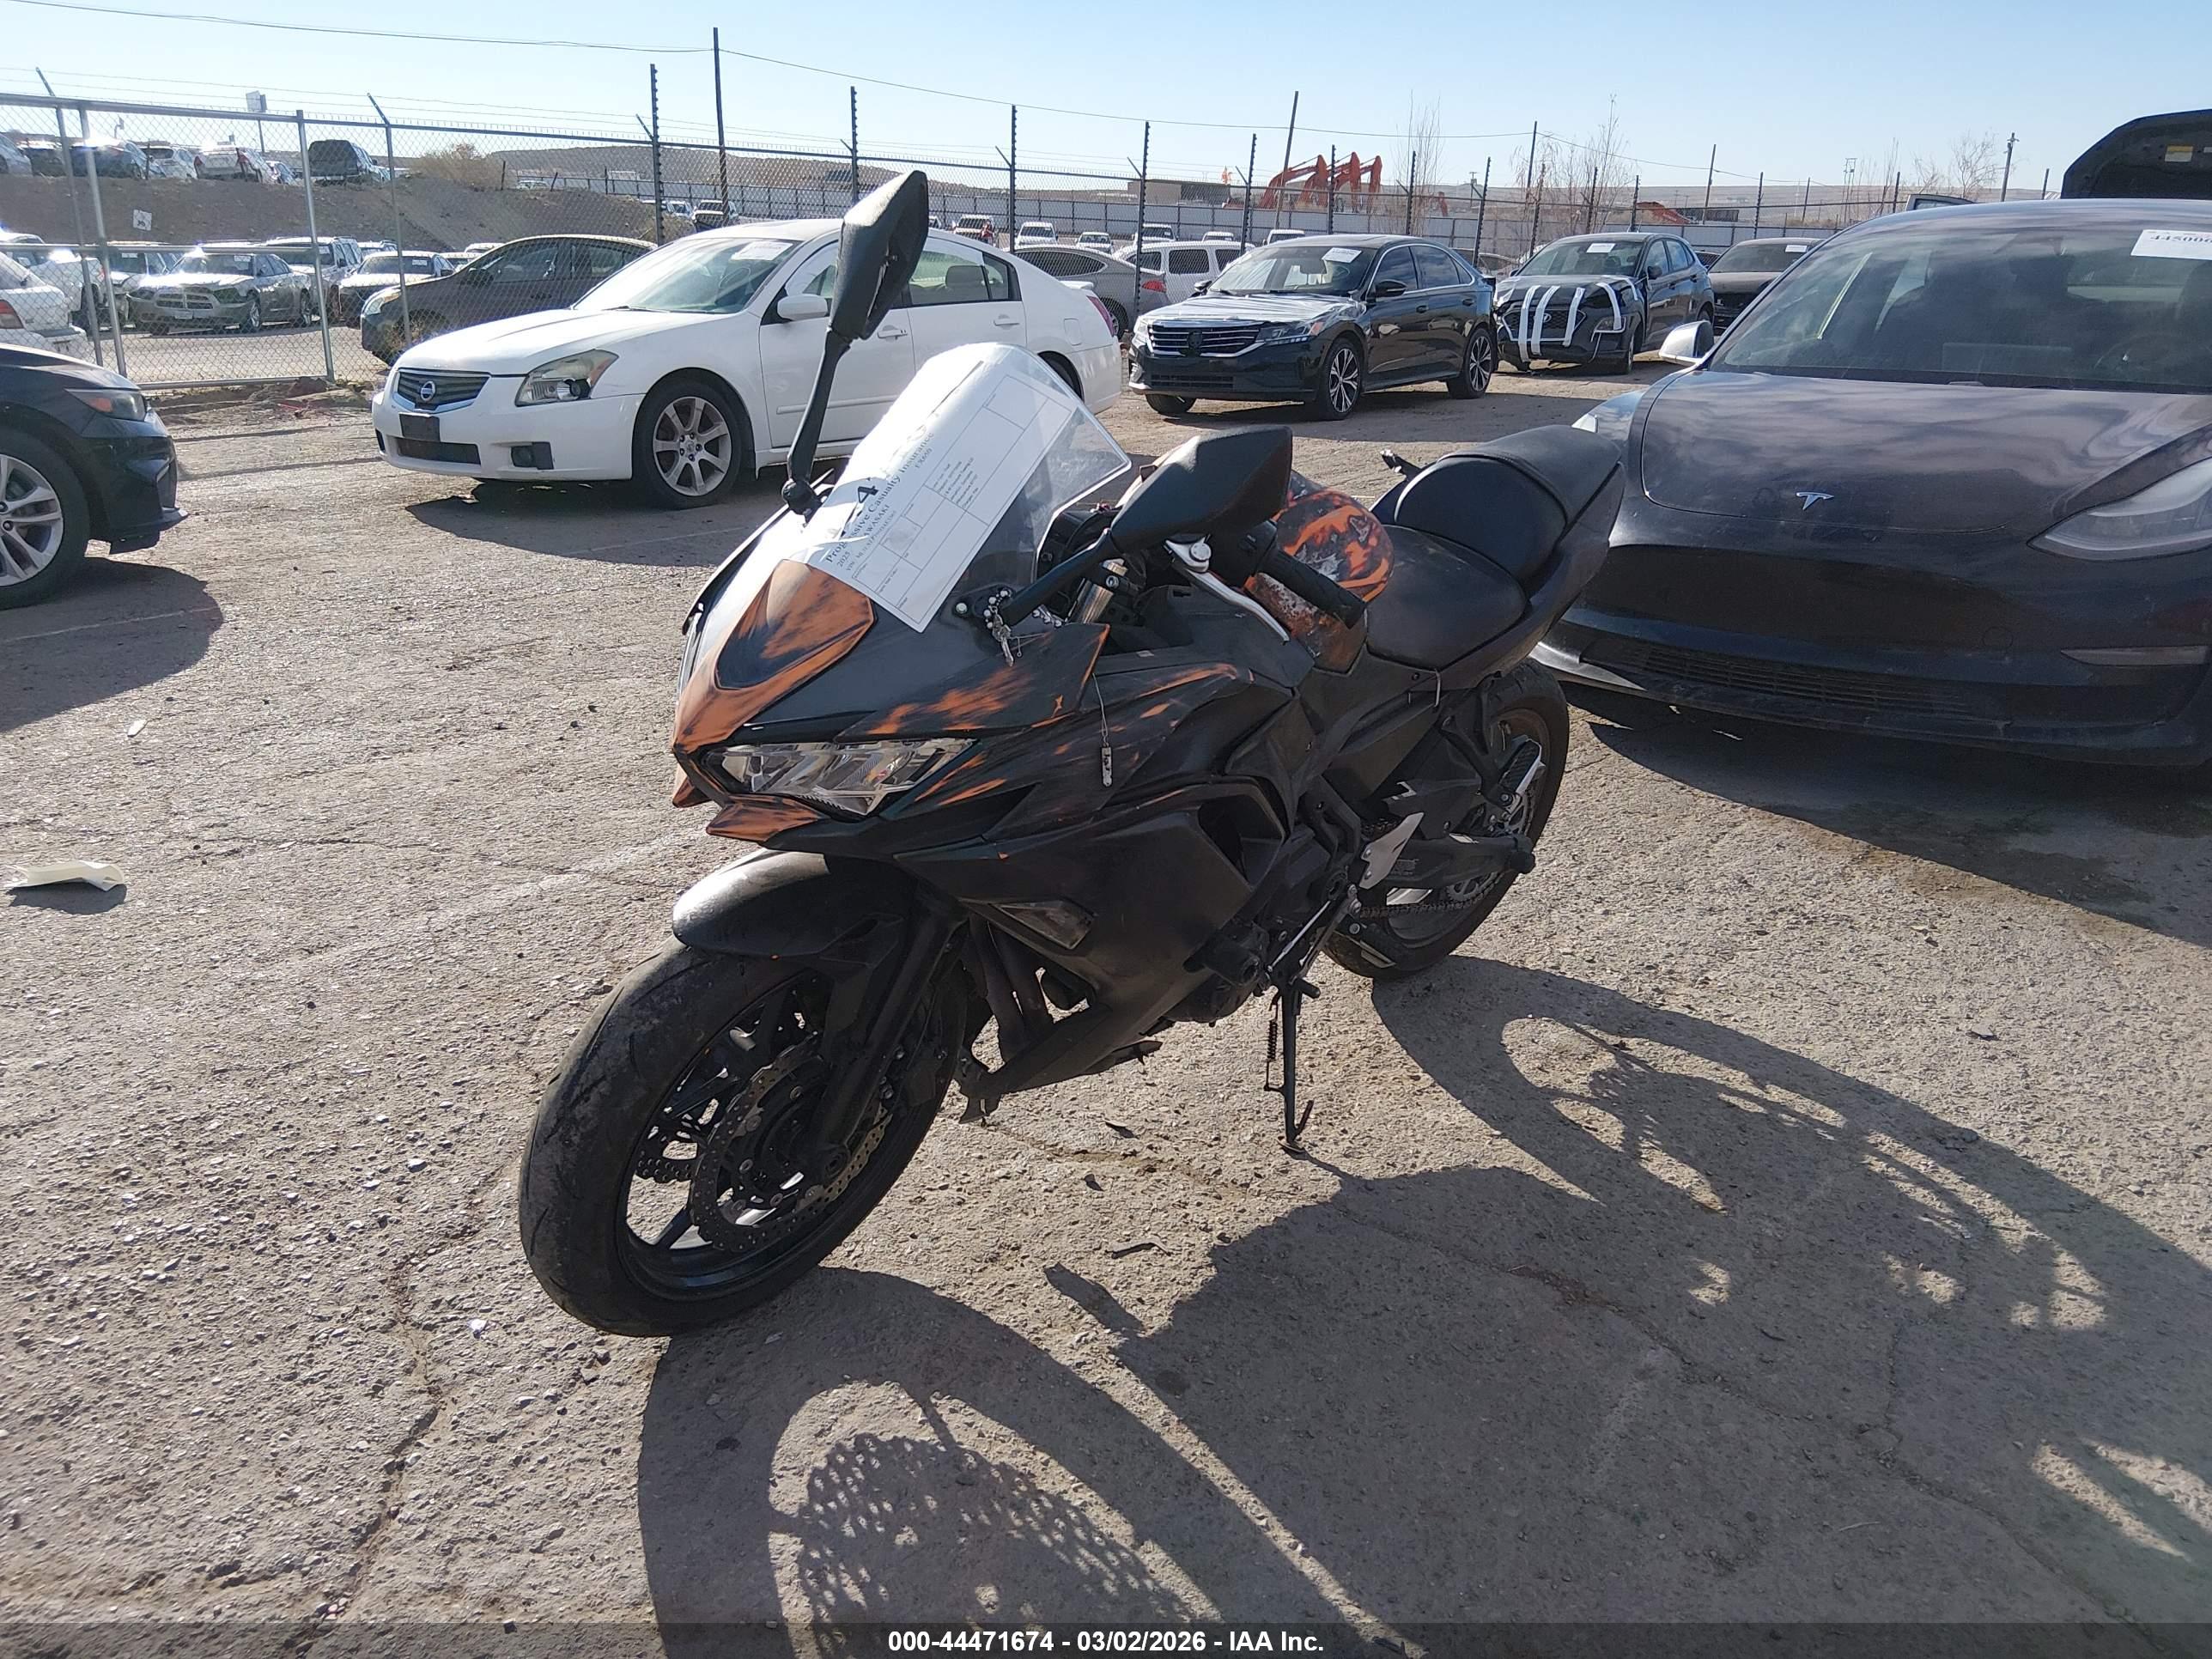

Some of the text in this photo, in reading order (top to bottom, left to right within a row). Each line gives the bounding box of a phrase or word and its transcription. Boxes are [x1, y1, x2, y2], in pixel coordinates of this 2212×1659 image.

[866, 474, 901, 515] Casualty
[897, 430, 935, 473] Insurance
[836, 550, 852, 568] 2025
[862, 503, 890, 537] AWASAKI
